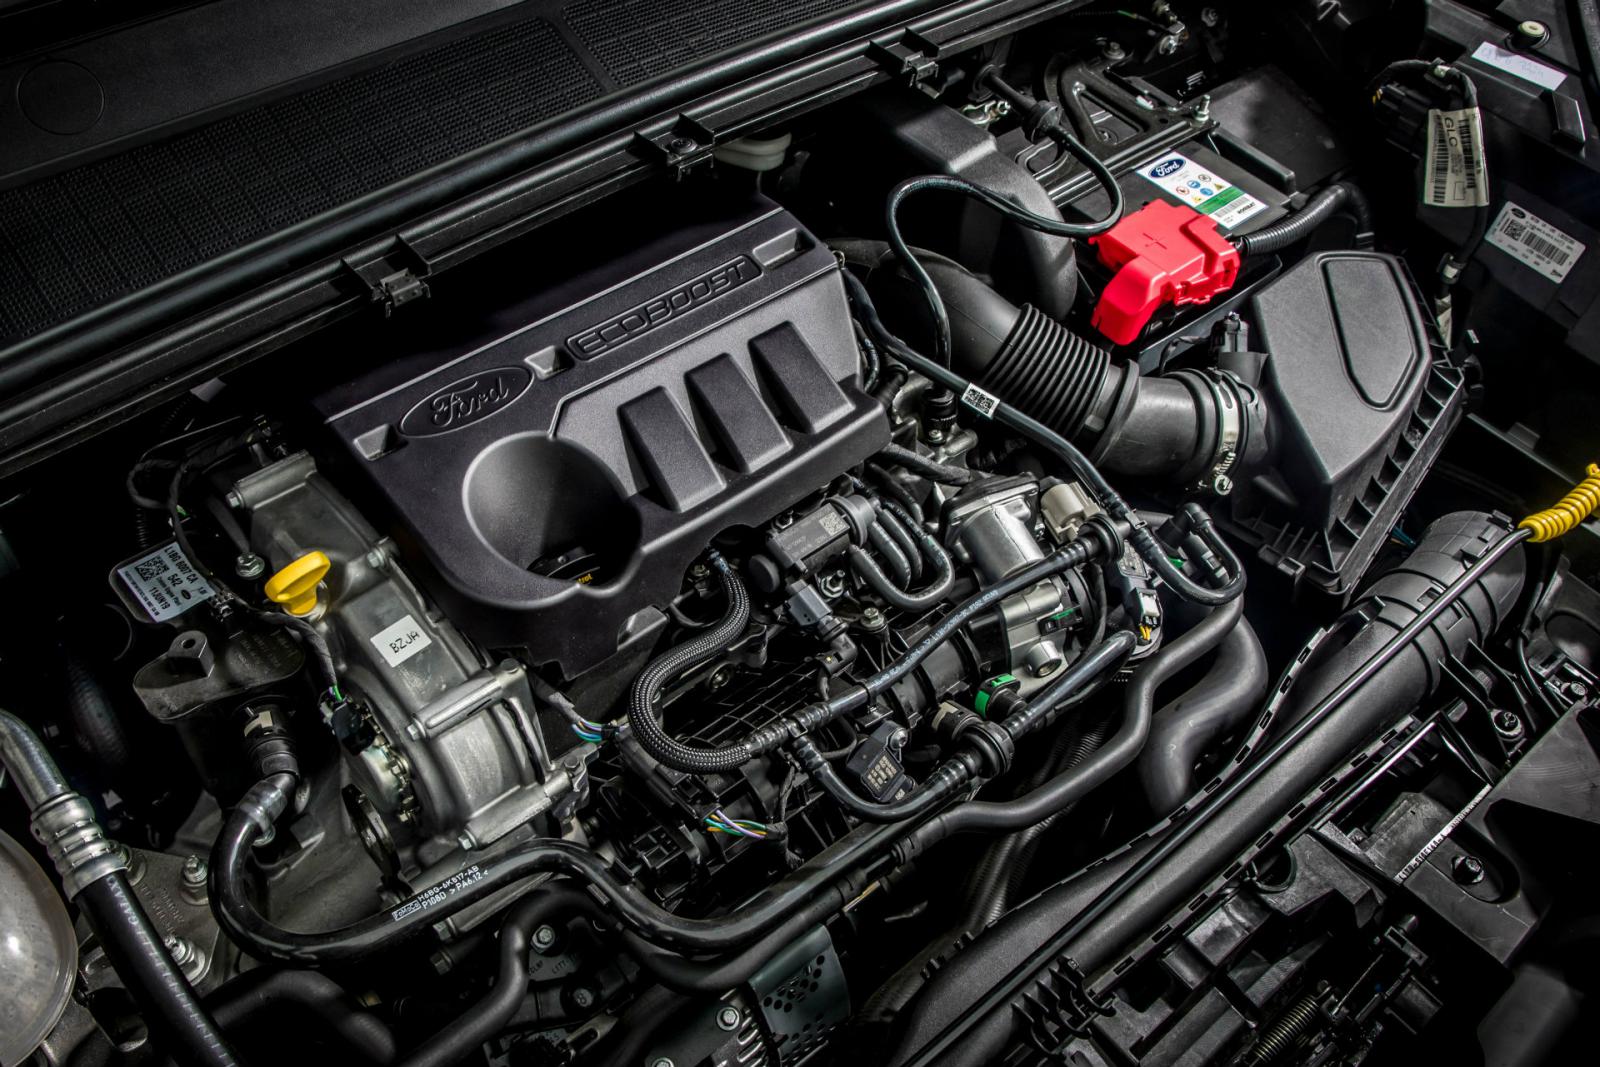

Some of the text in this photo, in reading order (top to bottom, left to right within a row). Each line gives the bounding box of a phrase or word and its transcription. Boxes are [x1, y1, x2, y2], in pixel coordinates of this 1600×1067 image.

[1154, 160, 1181, 177] Ford
[431, 376, 511, 427] Ford
[389, 631, 420, 653] BZJA
